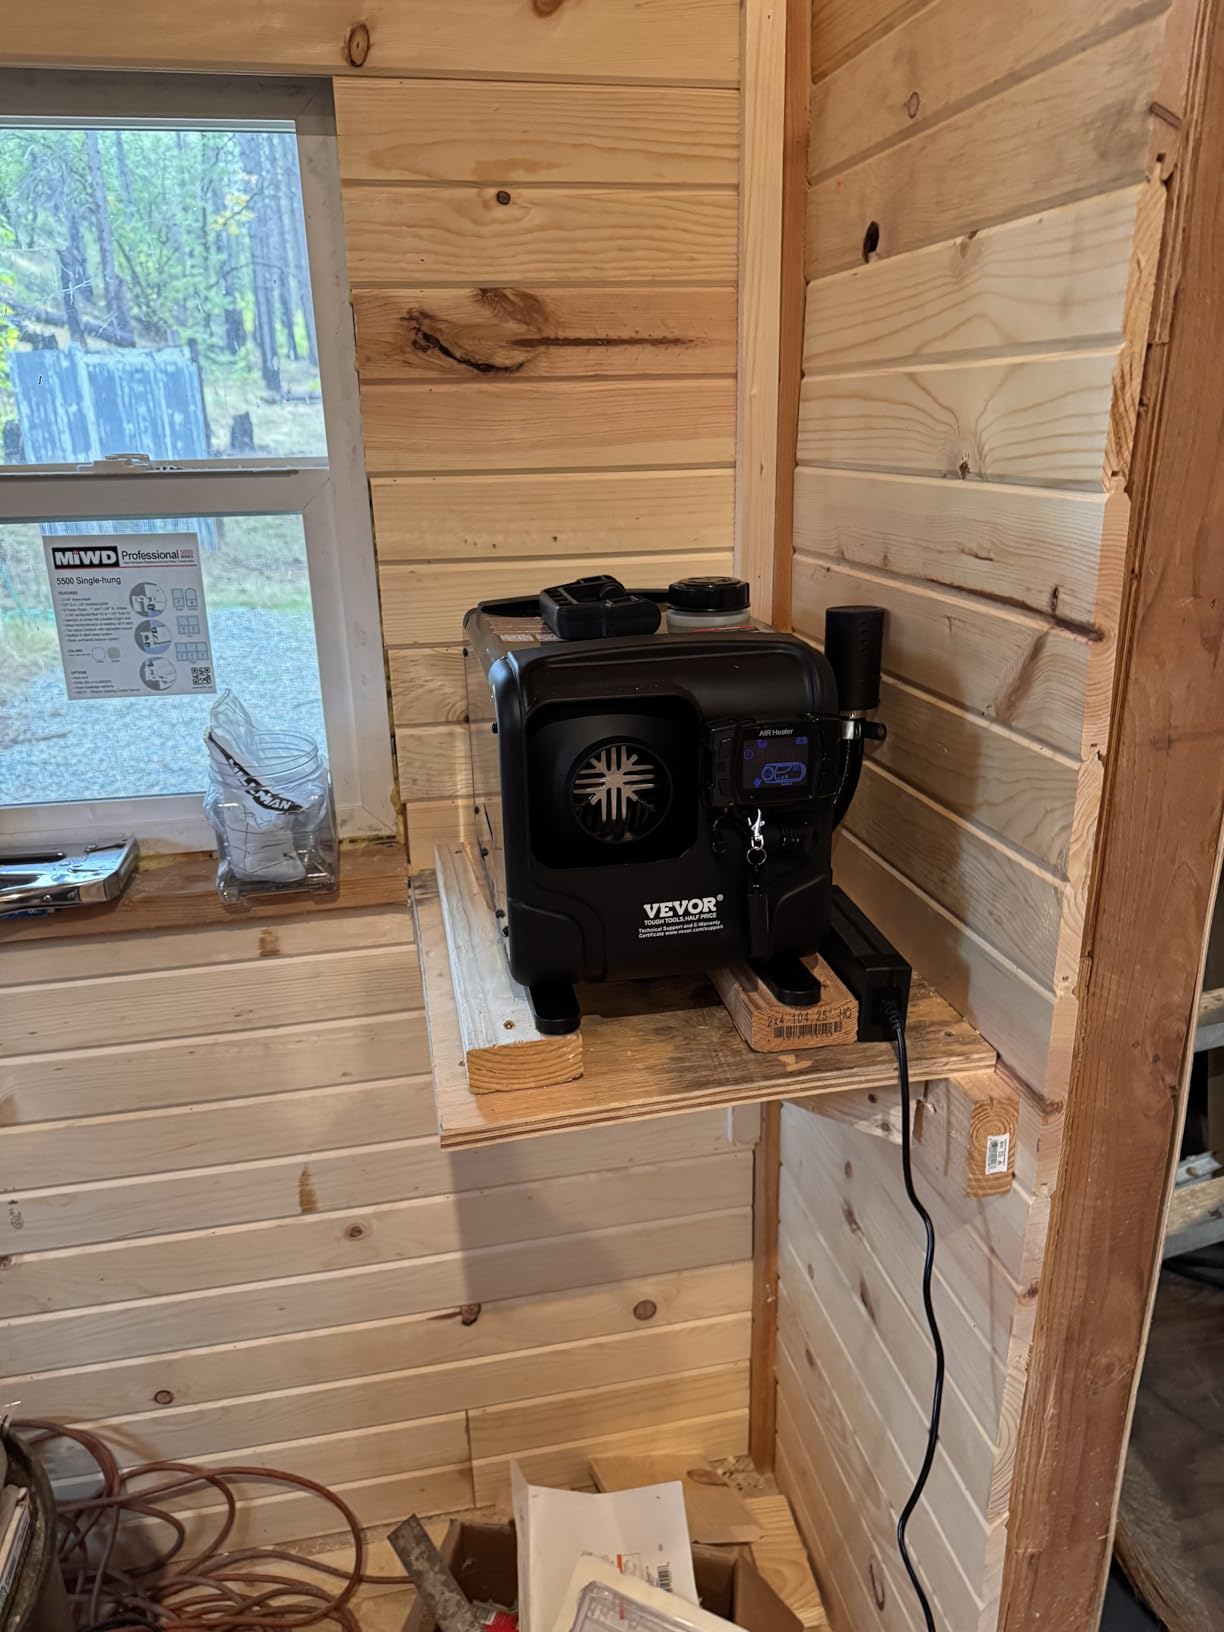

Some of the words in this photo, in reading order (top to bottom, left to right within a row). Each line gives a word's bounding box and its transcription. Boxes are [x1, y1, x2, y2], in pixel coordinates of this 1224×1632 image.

[121, 549, 180, 561] Professional
[56, 577, 75, 585] 5500
[76, 576, 122, 585] Single-hung
[759, 729, 772, 737] AIR
[772, 728, 794, 736] Heater
[700, 912, 717, 920] PRICE
[638, 926, 662, 934] Technical
[663, 924, 683, 932] Support
